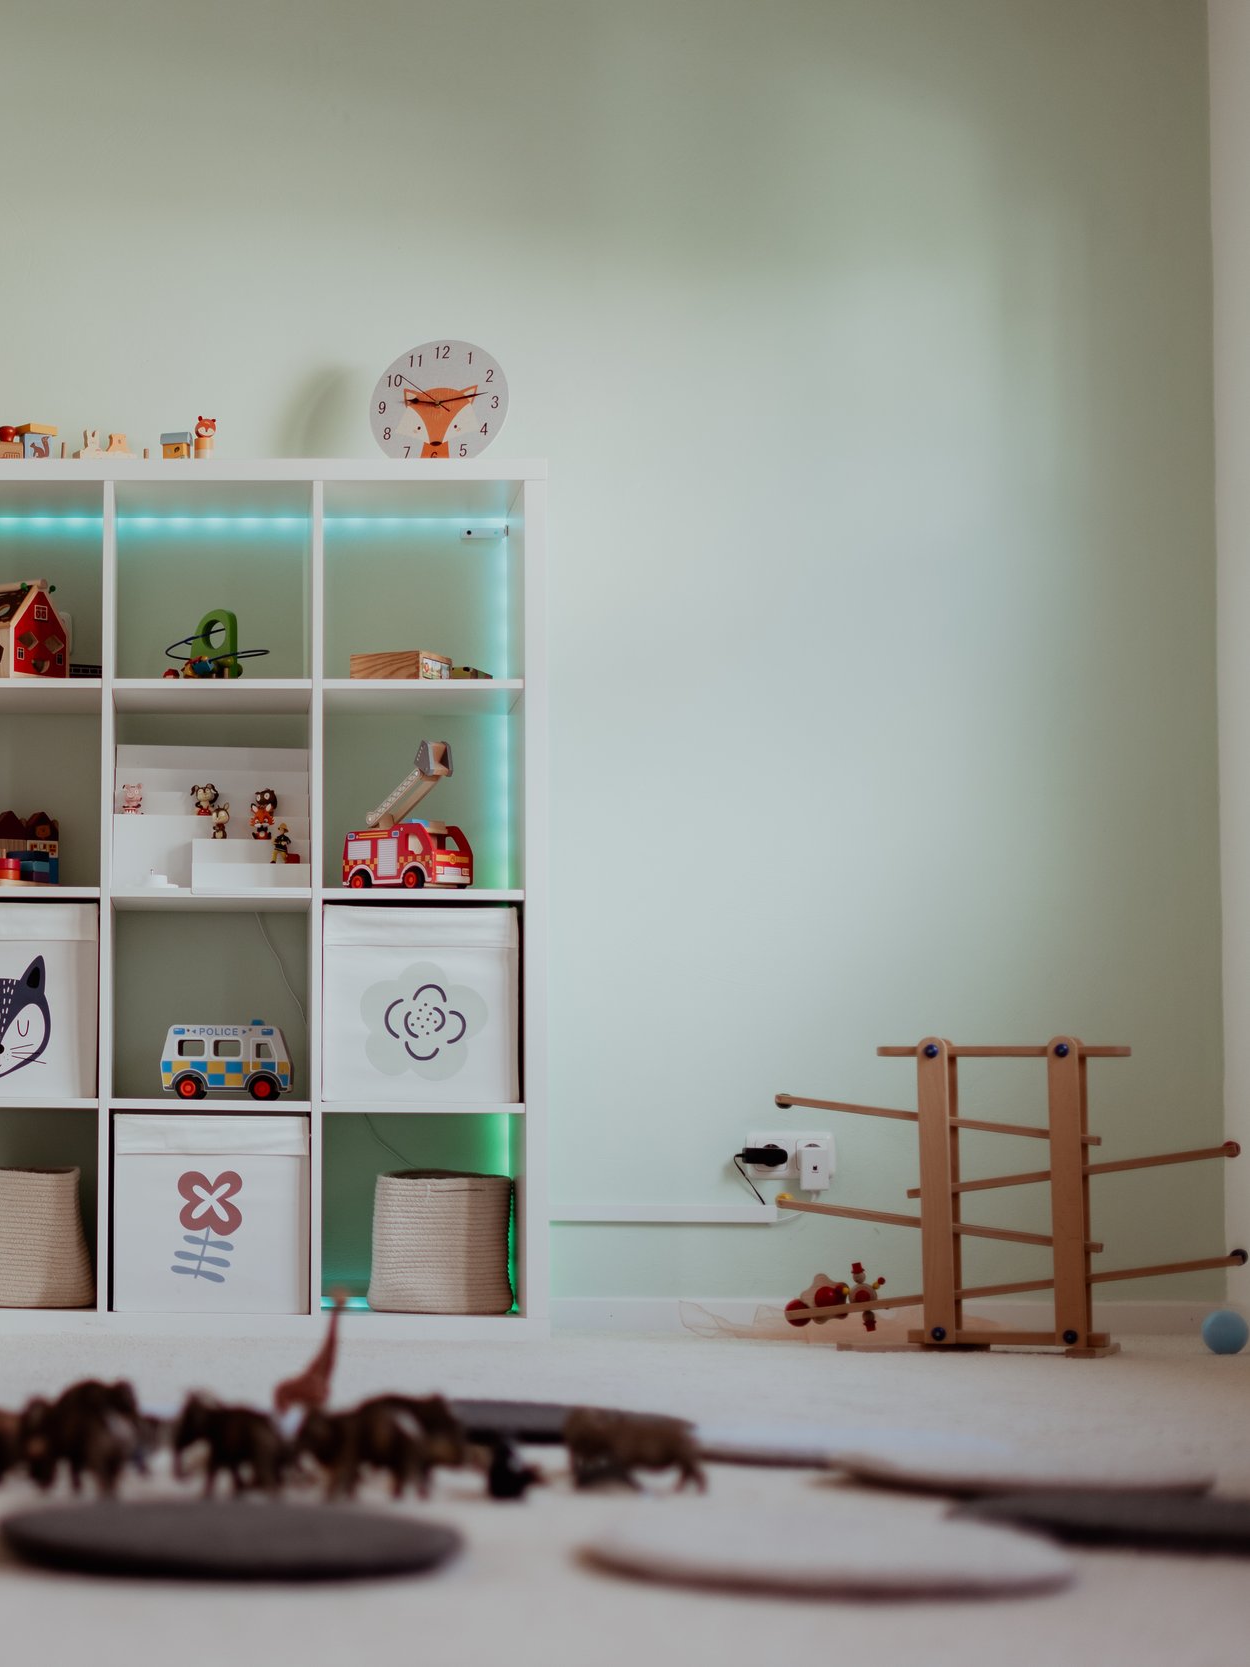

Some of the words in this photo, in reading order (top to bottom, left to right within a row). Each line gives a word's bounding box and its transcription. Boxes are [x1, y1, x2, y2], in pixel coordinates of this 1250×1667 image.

[435, 345, 451, 360] 12
[467, 351, 473, 365] 1
[409, 354, 423, 368] 11
[386, 373, 403, 388] 10
[485, 369, 494, 383] 2
[378, 401, 387, 415] 9
[490, 395, 499, 409] 3
[383, 426, 392, 441] 8
[479, 422, 489, 436] 4
[403, 446, 411, 459] 7
[459, 443, 468, 457] 5
[199, 1027, 239, 1036] POLICE
